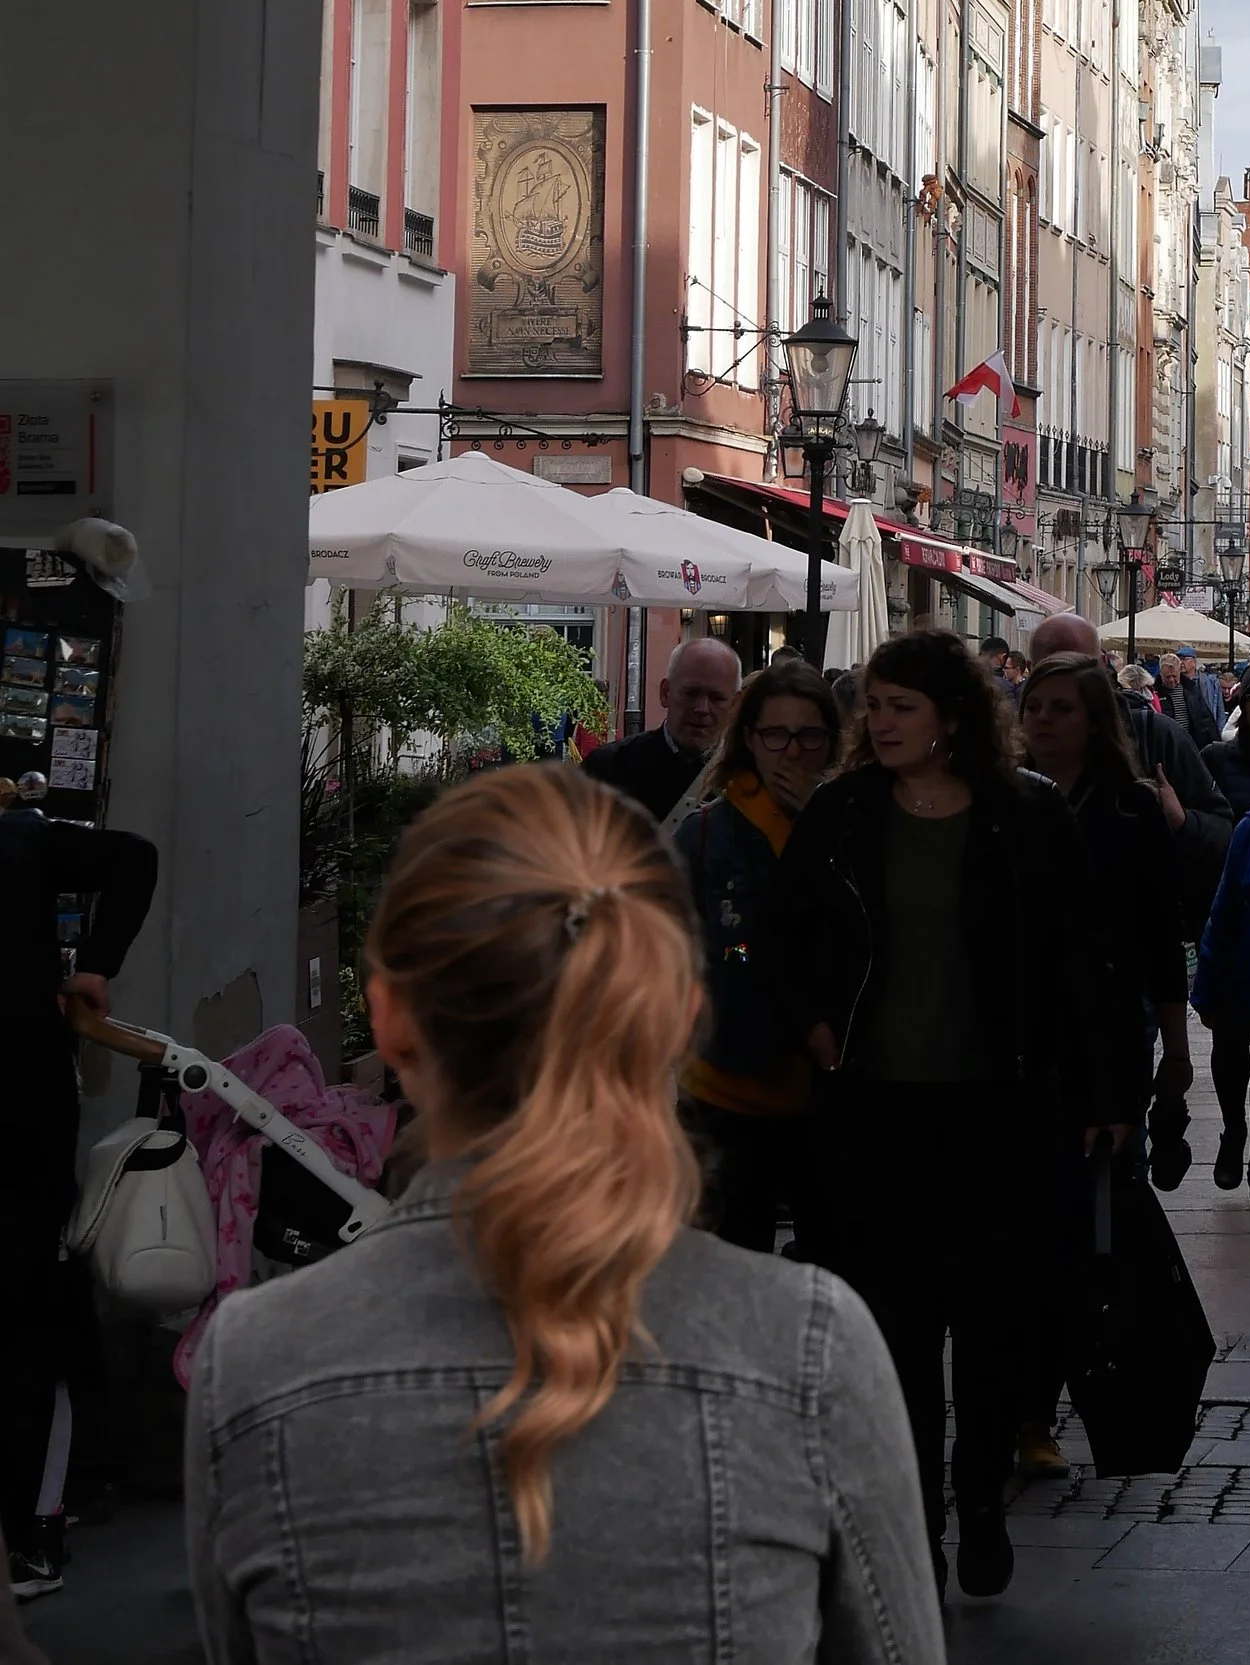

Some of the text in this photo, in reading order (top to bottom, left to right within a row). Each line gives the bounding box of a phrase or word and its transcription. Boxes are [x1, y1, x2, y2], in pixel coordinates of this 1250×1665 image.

[311, 550, 350, 559] BRODACZ
[509, 570, 540, 579] POLAND
[700, 573, 727, 584] BRODACZ
[1160, 571, 1180, 582] Lody
